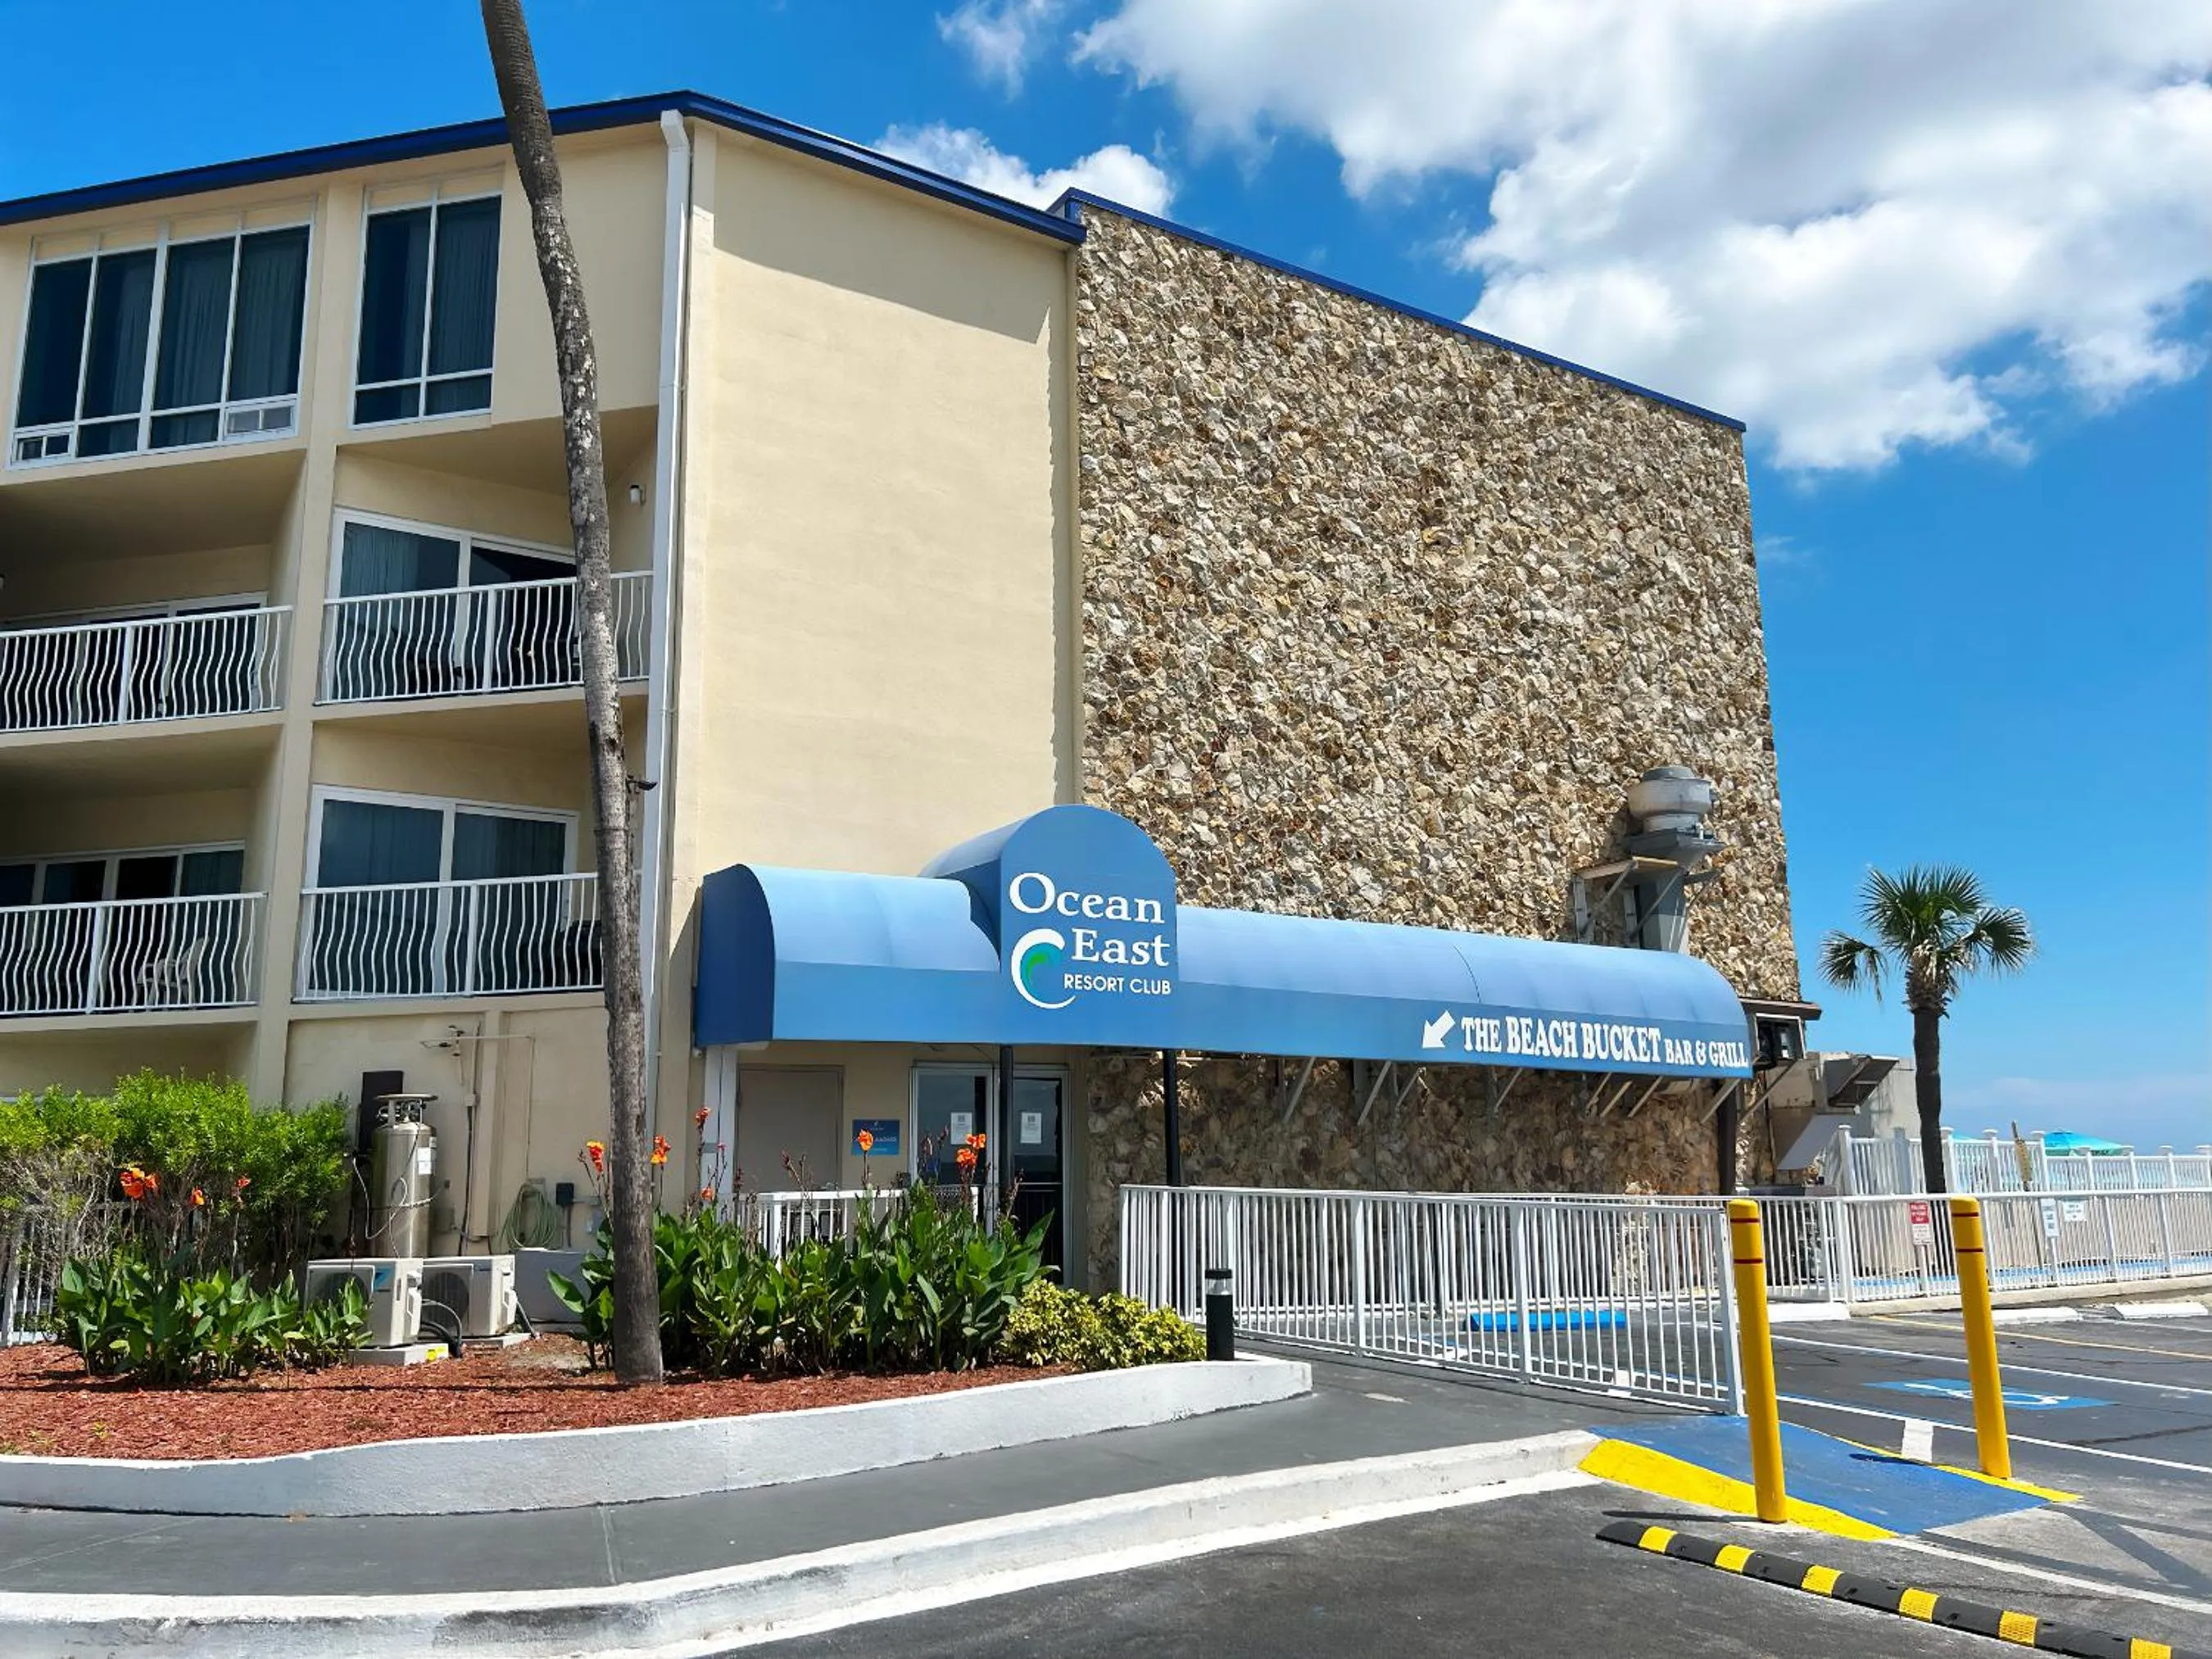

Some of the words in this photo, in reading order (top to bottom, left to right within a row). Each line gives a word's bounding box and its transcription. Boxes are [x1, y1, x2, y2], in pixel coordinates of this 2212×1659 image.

[1009, 872, 1165, 923] Ocean
[1072, 927, 1171, 967] East
[1064, 973, 1124, 993] RESORT
[1130, 978, 1172, 995] CLUB
[1462, 1016, 1502, 1053] THE
[1506, 1015, 1579, 1058] BEACH
[1580, 1022, 1661, 1063] BUCKET
[1664, 1038, 1693, 1065] BAR
[1695, 1040, 1707, 1065] &
[1708, 1040, 1748, 1067] GRILL
